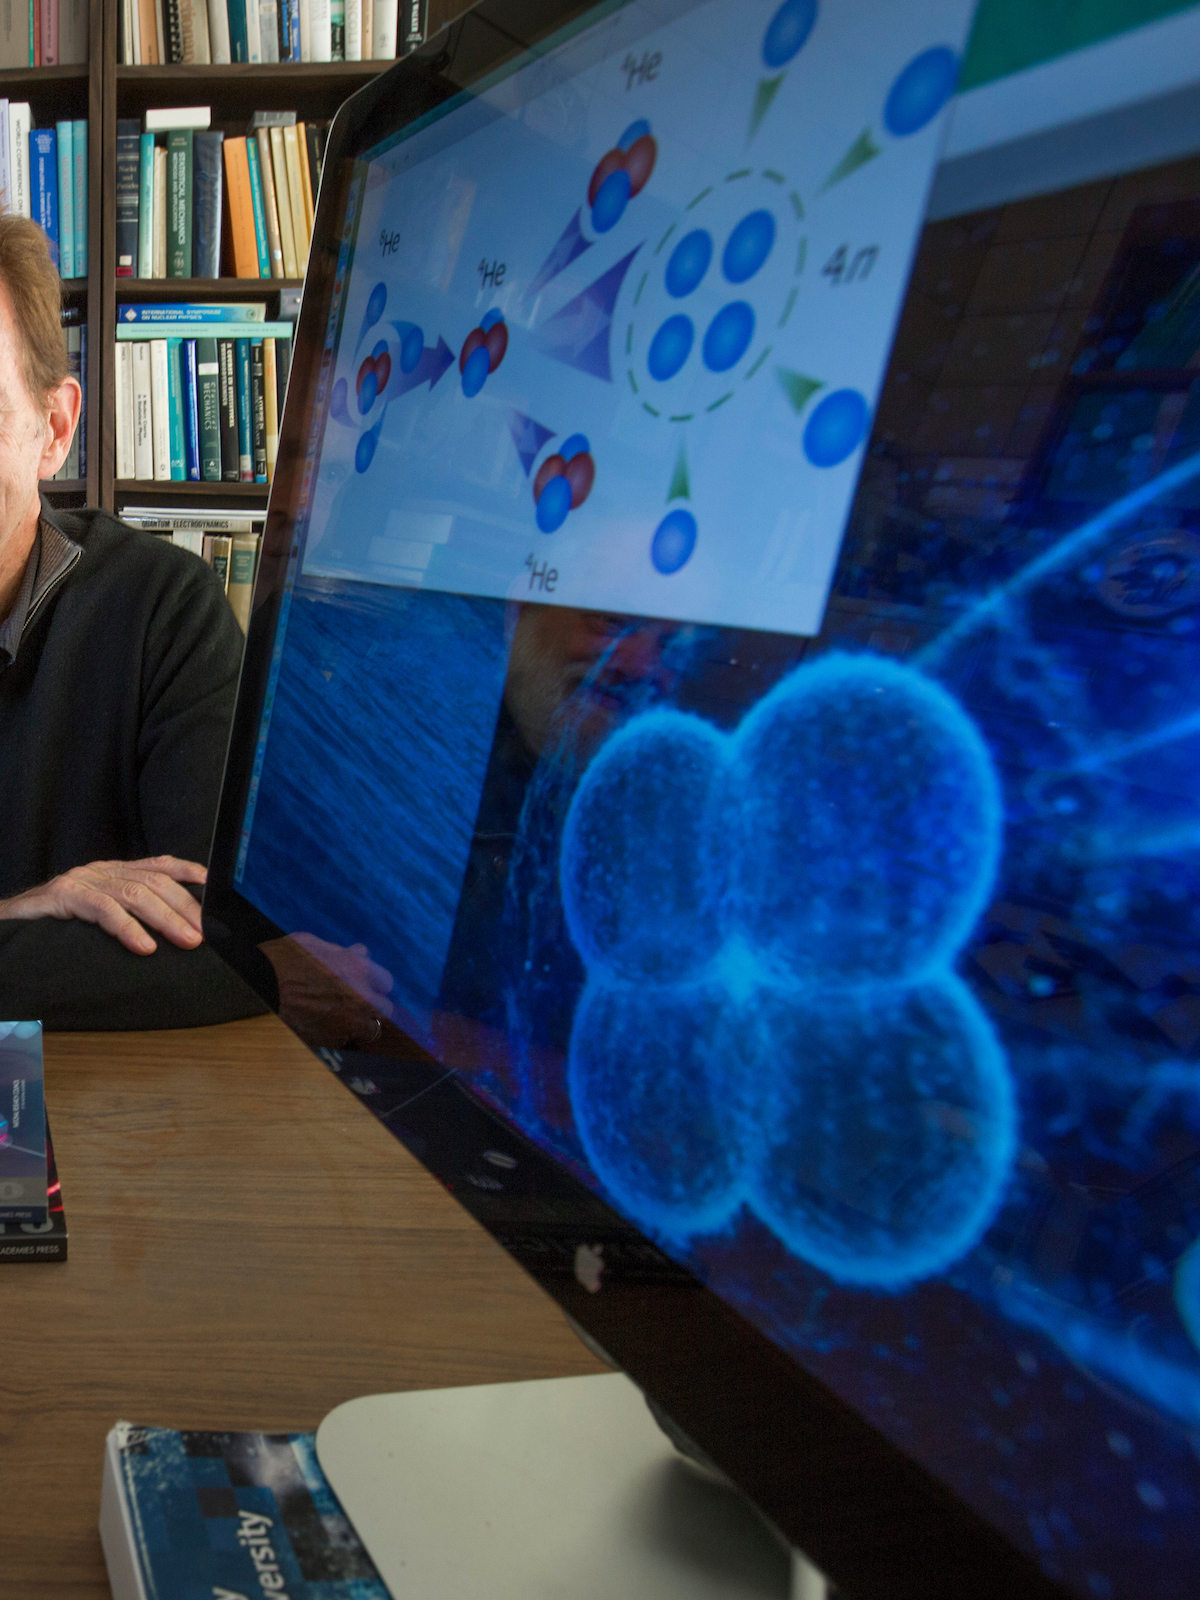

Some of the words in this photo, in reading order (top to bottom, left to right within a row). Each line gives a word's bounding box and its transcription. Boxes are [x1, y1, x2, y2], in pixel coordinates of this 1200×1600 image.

[62, 155, 70, 190] MESONS
[178, 151, 186, 198] STATISTICAL
[18, 199, 23, 211] ON
[178, 199, 186, 244] MECHANICS
[477, 256, 508, 290] 4He
[220, 343, 228, 406] THERMODYNAMICS
[228, 377, 234, 385] IN
[203, 383, 212, 430] MECHANICS
[141, 519, 170, 529] QUANTUM
[173, 519, 229, 529] ELECTRODYNAMICS
[524, 551, 559, 593] 4He
[36, 1246, 59, 1254] PRESS
